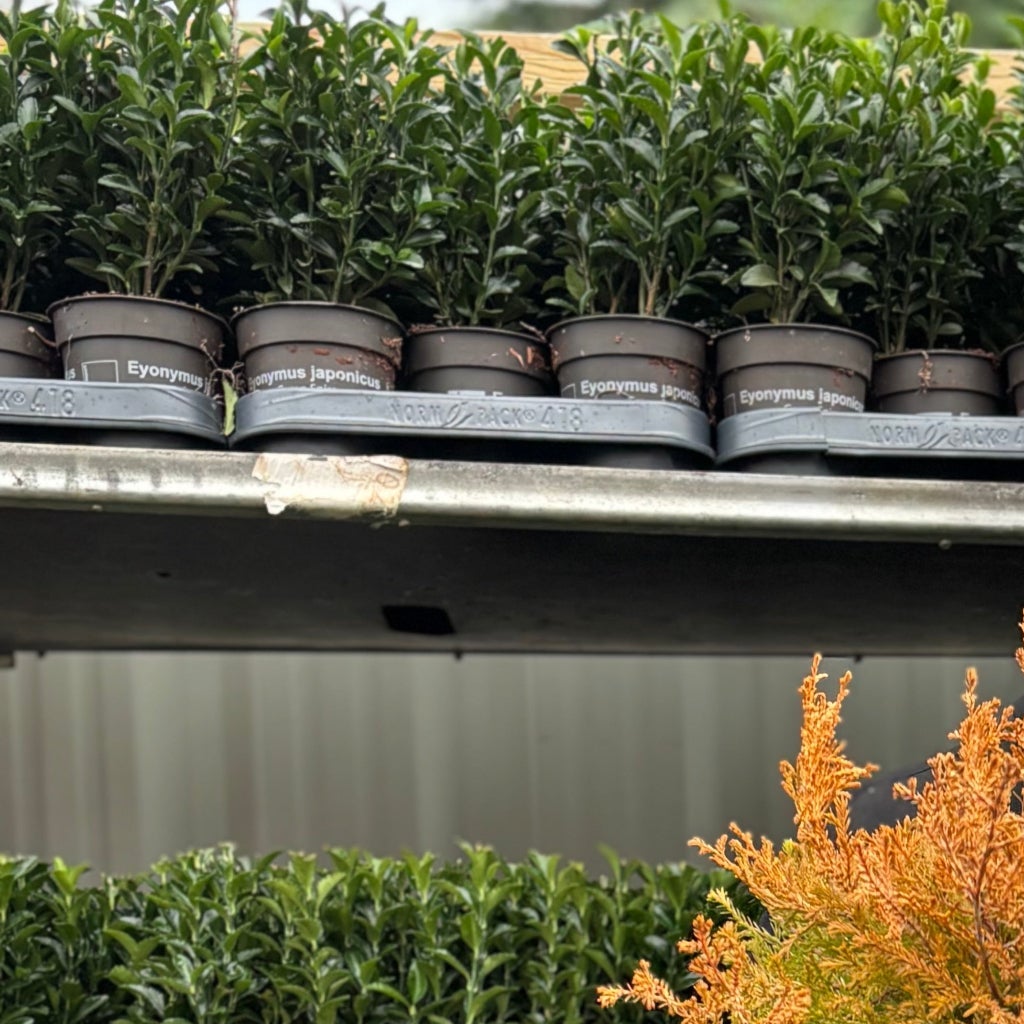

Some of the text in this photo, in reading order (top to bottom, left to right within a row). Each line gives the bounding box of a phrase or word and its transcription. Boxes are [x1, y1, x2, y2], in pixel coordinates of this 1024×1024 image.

[310, 365, 381, 390] japonicus
[580, 380, 658, 397] Eyonymus
[740, 388, 815, 406] Eyonymus
